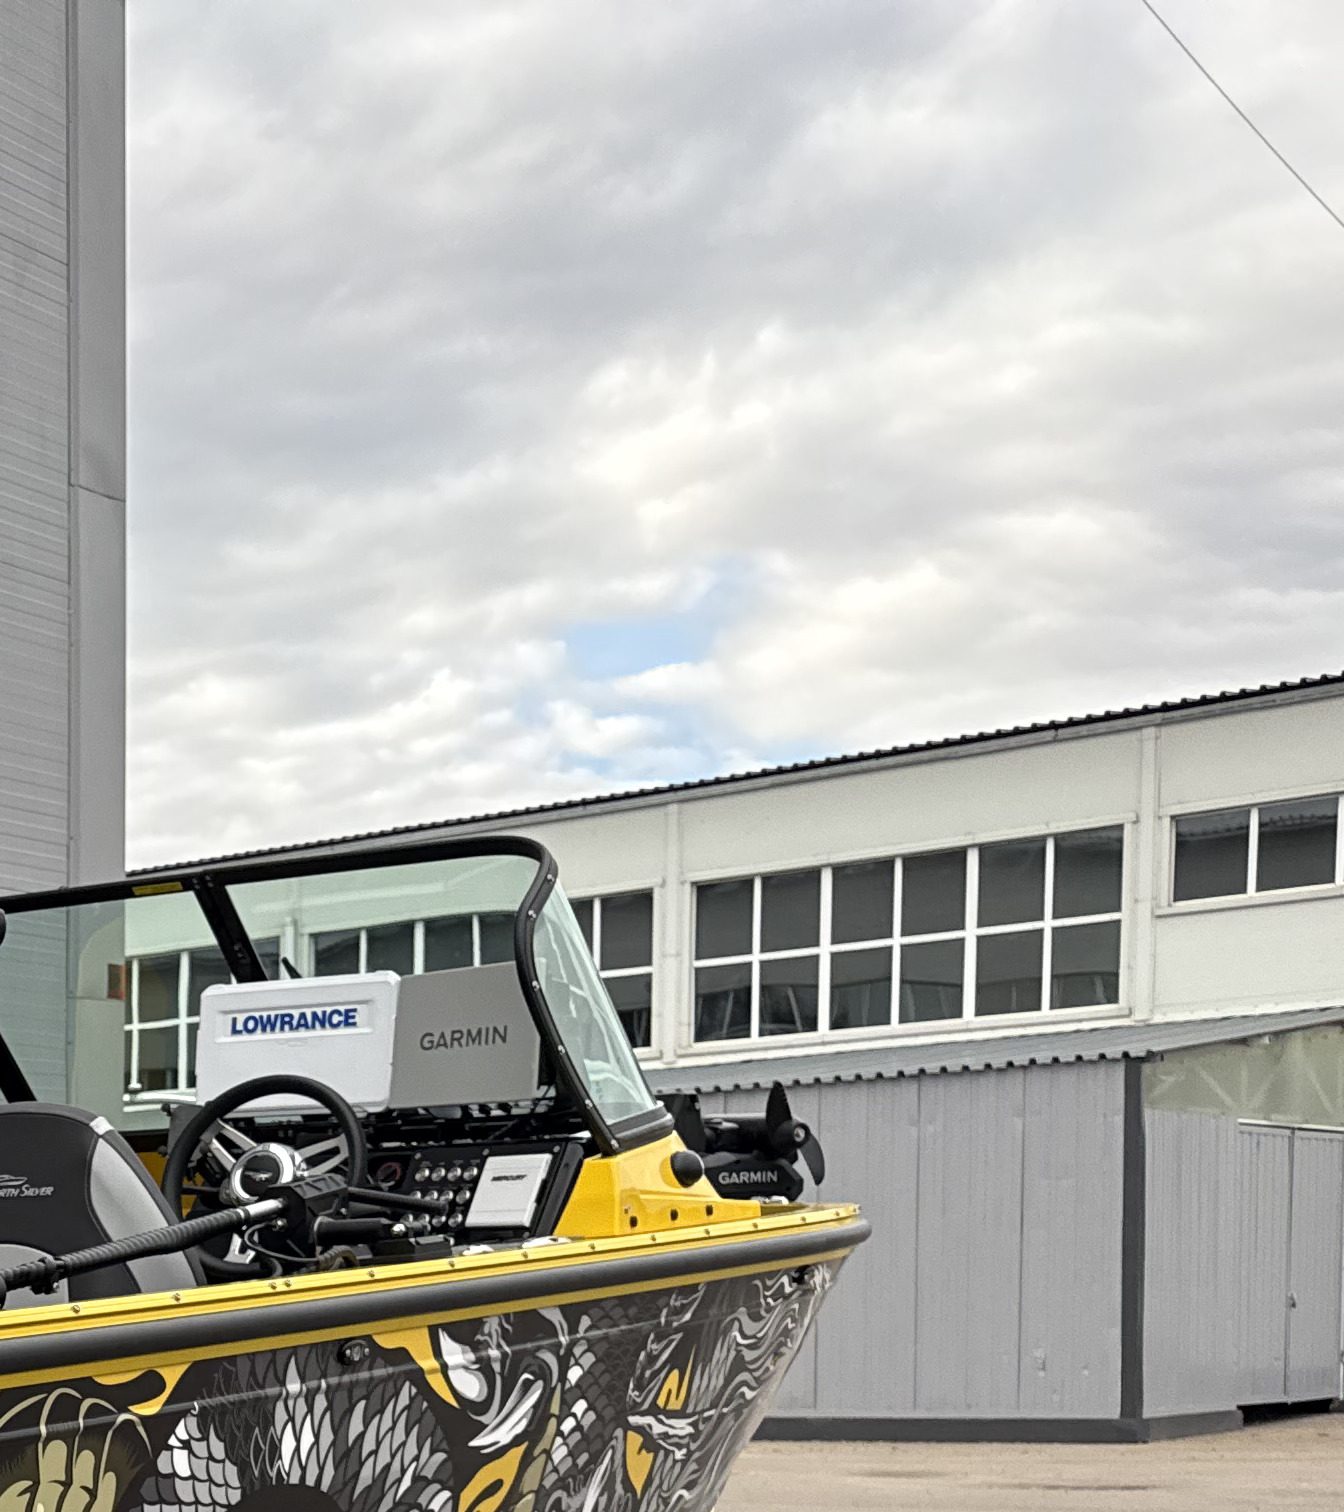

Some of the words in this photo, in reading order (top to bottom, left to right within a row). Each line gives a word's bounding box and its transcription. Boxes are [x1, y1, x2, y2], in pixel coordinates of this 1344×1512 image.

[230, 1008, 358, 1035] LOWRANCE
[420, 1025, 507, 1051] GARMIN
[718, 1170, 778, 1184] GARMIN
